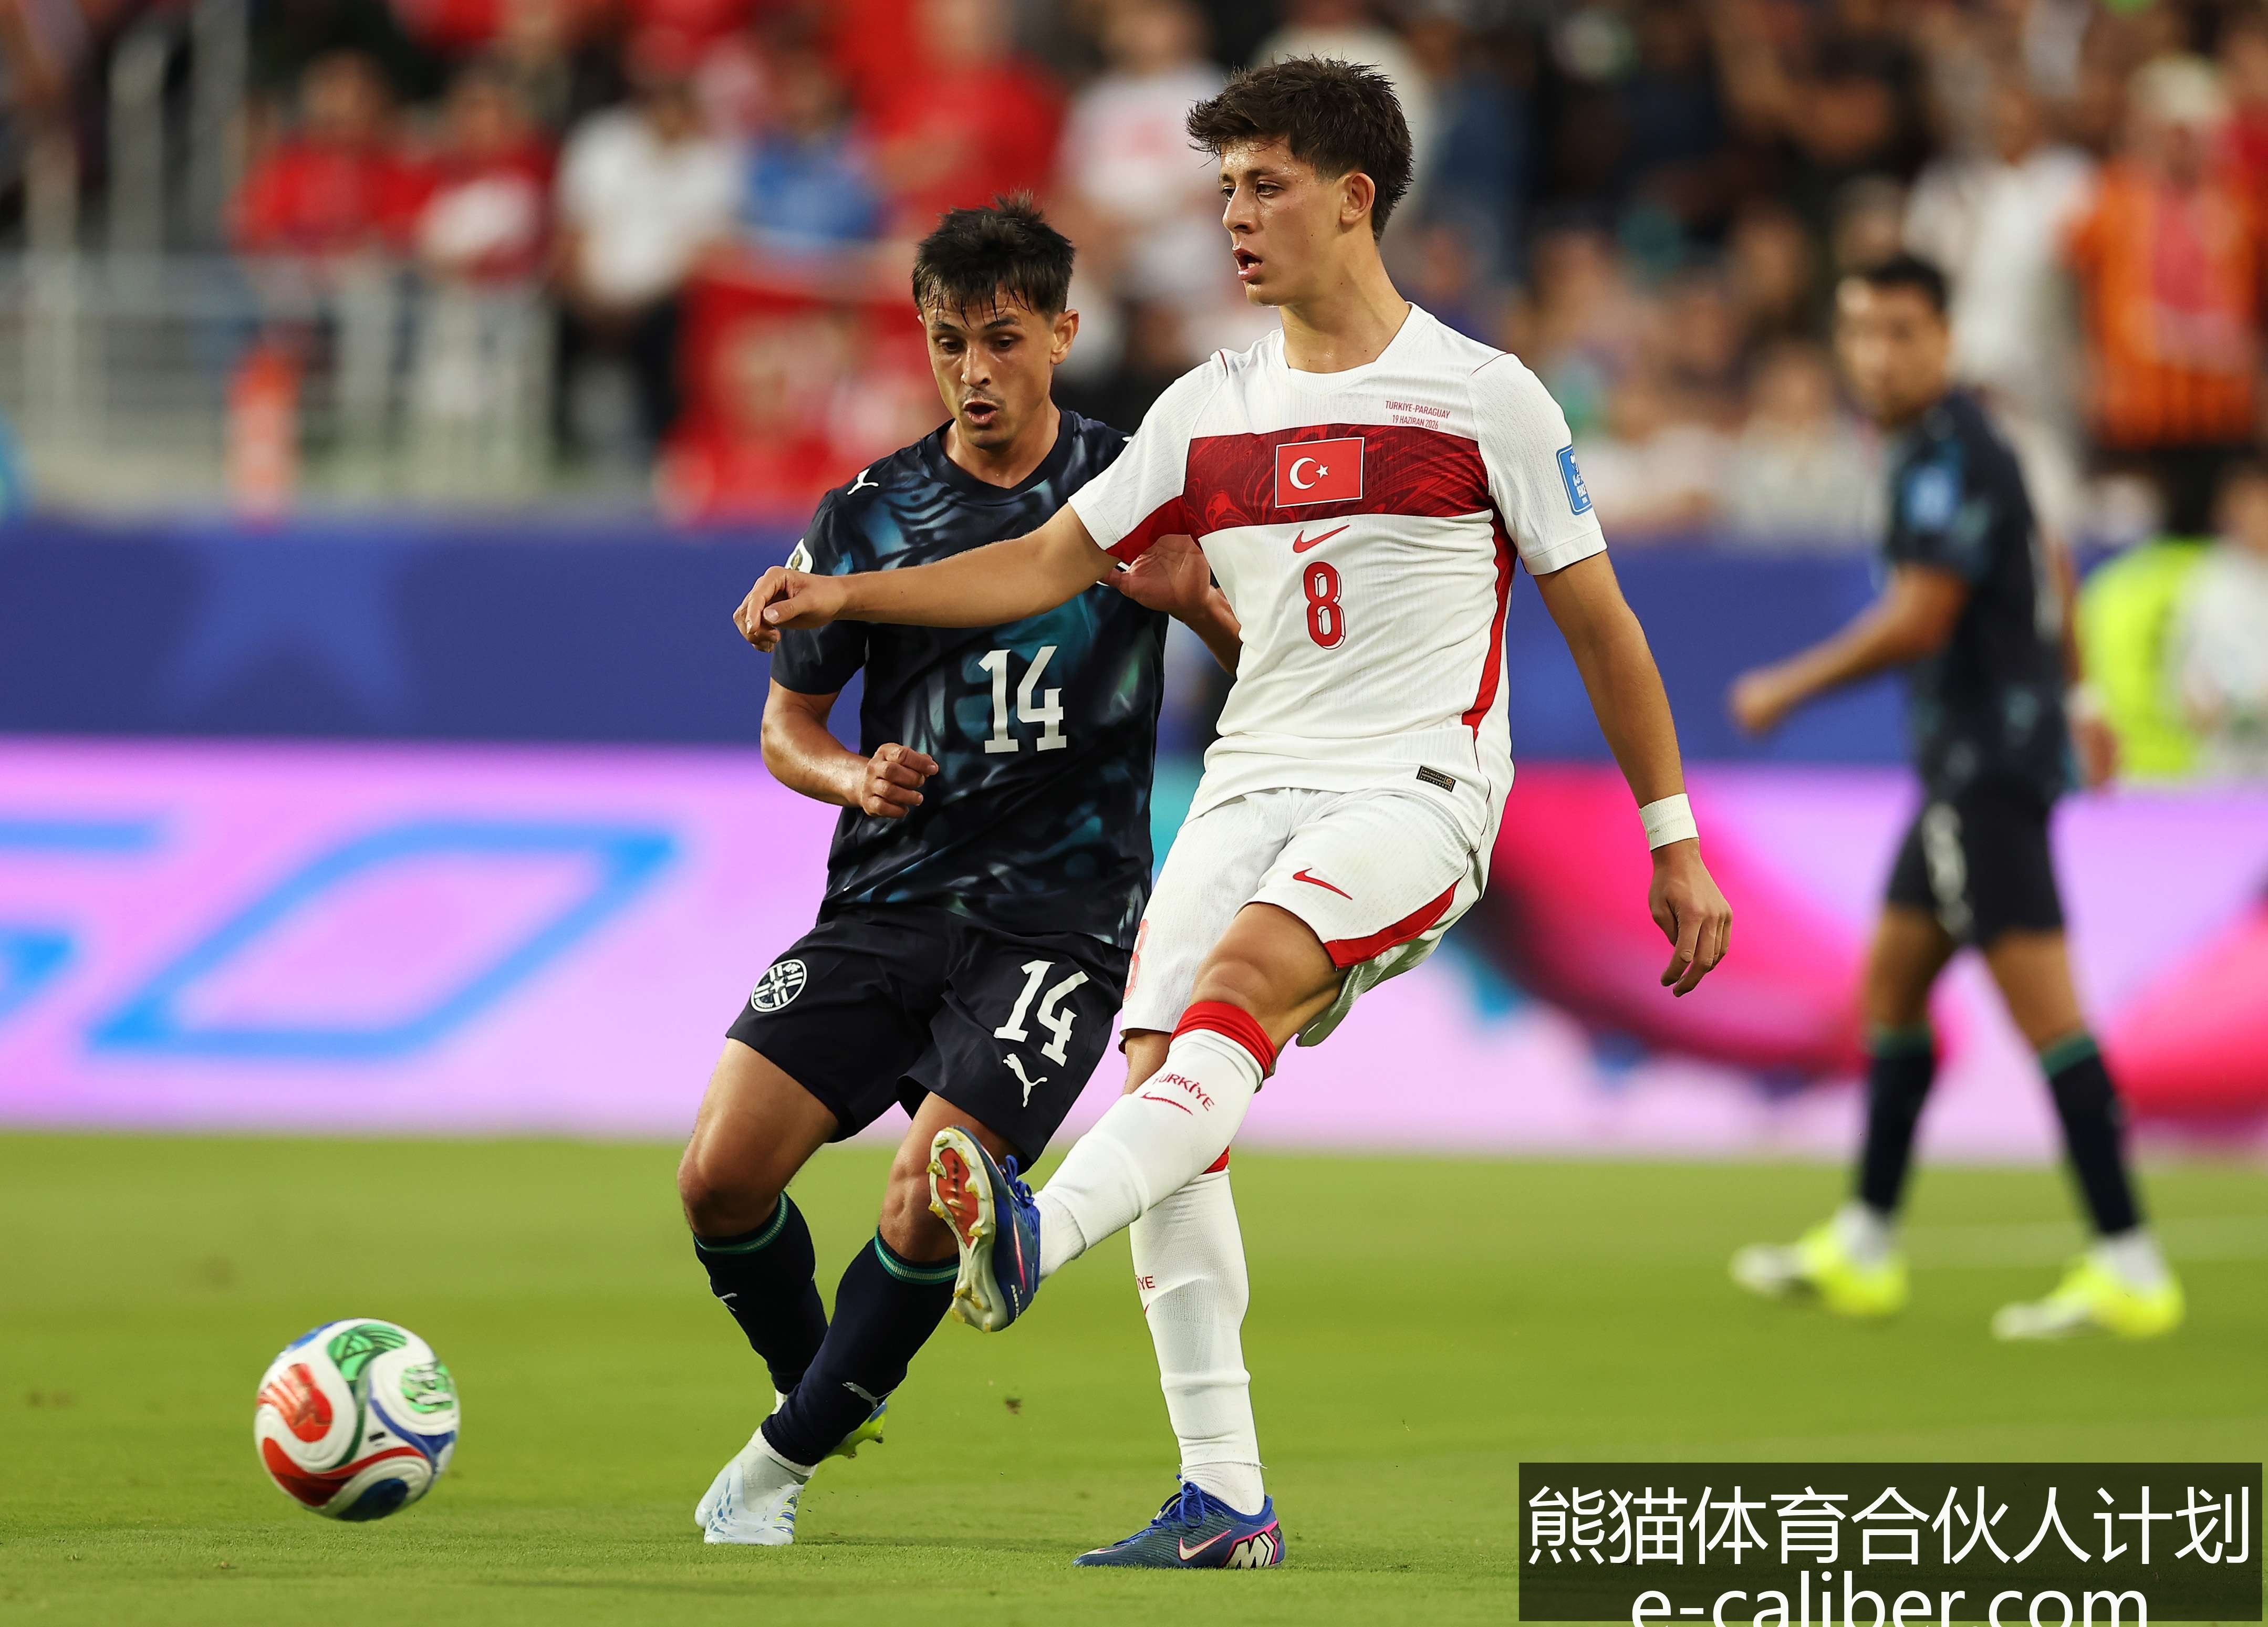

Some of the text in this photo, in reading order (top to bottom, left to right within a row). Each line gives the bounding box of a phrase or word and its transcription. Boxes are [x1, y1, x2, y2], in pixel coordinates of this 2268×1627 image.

[1385, 399, 1450, 419] TÜRKİYE-PARAGUAY
[1392, 414, 1439, 430] 19 HAZİRAN 2026
[1303, 561, 1346, 650] 8
[977, 645, 1067, 754] 14
[993, 959, 1089, 1067] 14
